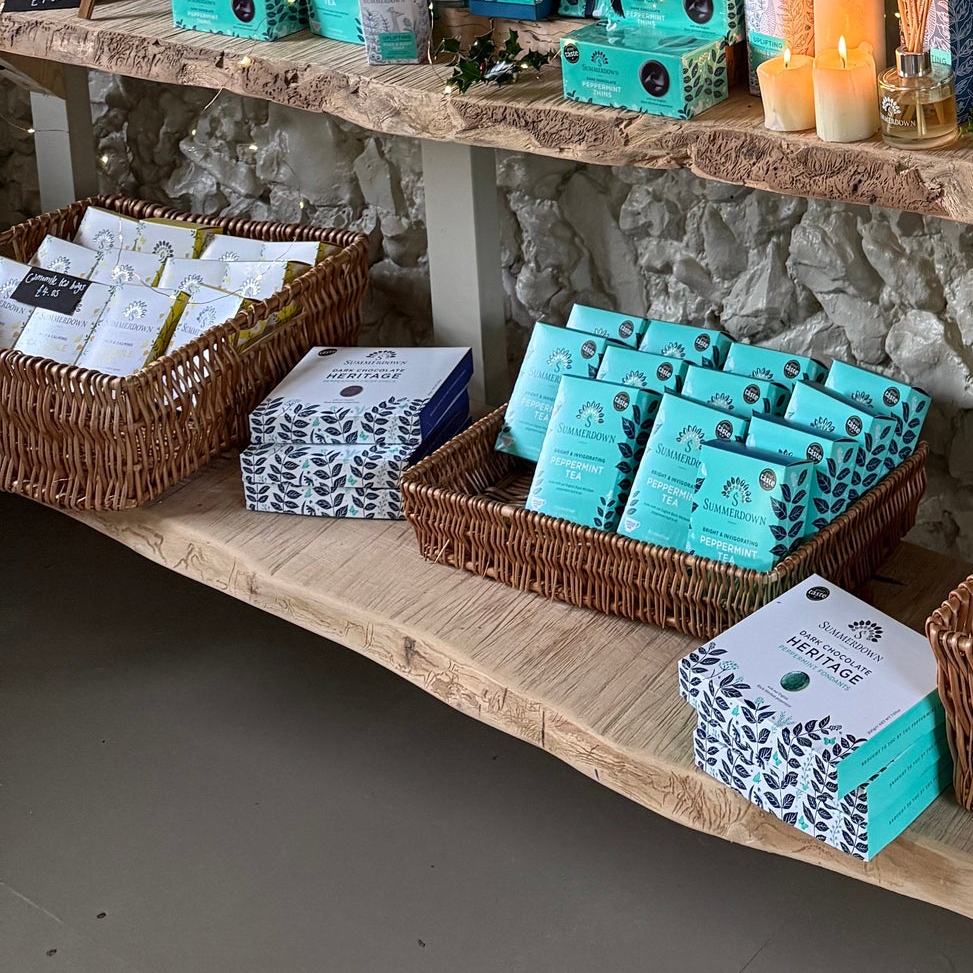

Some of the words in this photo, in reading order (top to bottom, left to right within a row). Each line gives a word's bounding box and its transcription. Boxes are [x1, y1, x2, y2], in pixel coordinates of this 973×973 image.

[626, 11, 665, 22] PEPPERMINT
[637, 18, 656, 28] THINS
[753, 36, 783, 49] UPLIFTING
[581, 81, 621, 93] PEPPERMINT
[593, 89, 613, 98] THINS
[582, 344, 596, 355] taste
[657, 367, 672, 377] taste
[785, 364, 799, 375] taste
[744, 389, 759, 400] taste
[884, 392, 898, 404] taste
[614, 396, 629, 408] taste
[557, 422, 617, 444] SUMMERDOWN
[717, 426, 731, 438] taste
[847, 419, 861, 434] taste
[807, 448, 822, 461] taste
[551, 457, 604, 474] PEPPERMINT
[565, 470, 582, 481] TEA
[760, 475, 776, 487] taste
[646, 478, 694, 500] PEPPERMIN
[661, 495, 679, 508] TEA
[702, 499, 767, 526] SUMMERDOWN
[702, 526, 719, 538] BRIGHT
[723, 532, 759, 547] INVIGORATING
[700, 535, 759, 559] PEPPERMINT
[717, 551, 735, 564] TEA
[808, 589, 828, 600] taste
[818, 620, 884, 663] SUMMERDOWN
[799, 629, 823, 646] DARK
[822, 643, 873, 676] CHOCOLATE
[786, 636, 864, 686] HERITAGE
[778, 644, 819, 669] PEPPERMINT
[818, 668, 851, 692] FONDANTS
